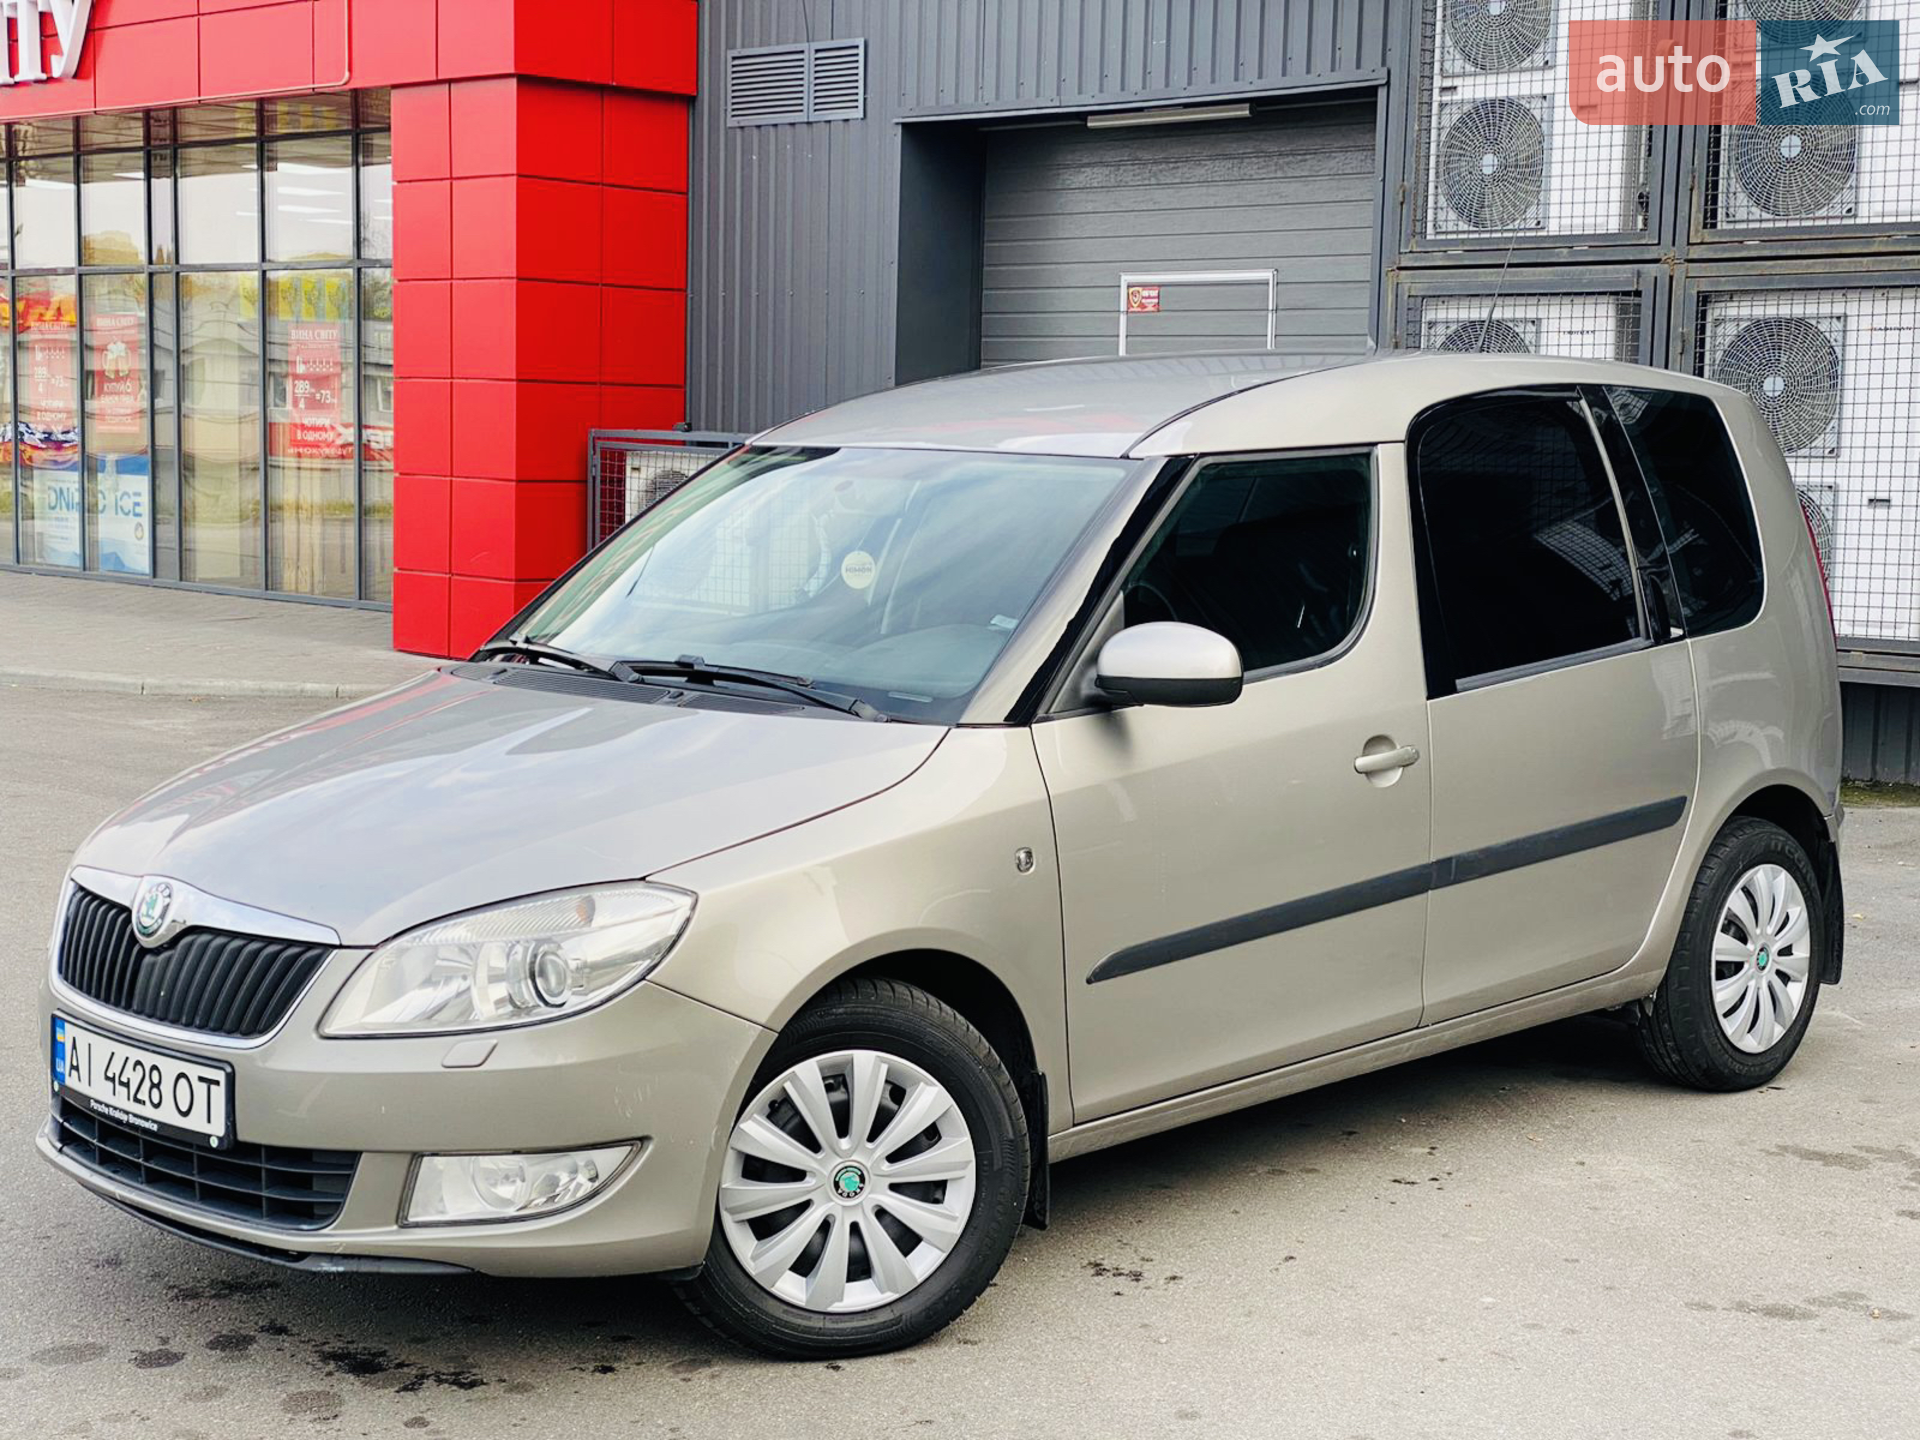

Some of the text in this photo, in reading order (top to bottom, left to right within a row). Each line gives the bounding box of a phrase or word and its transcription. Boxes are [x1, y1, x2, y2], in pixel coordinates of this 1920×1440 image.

[294, 380, 310, 393] 289
[115, 491, 142, 517] ICE
[104, 1051, 163, 1109] 4428
[173, 1072, 220, 1124] OT
